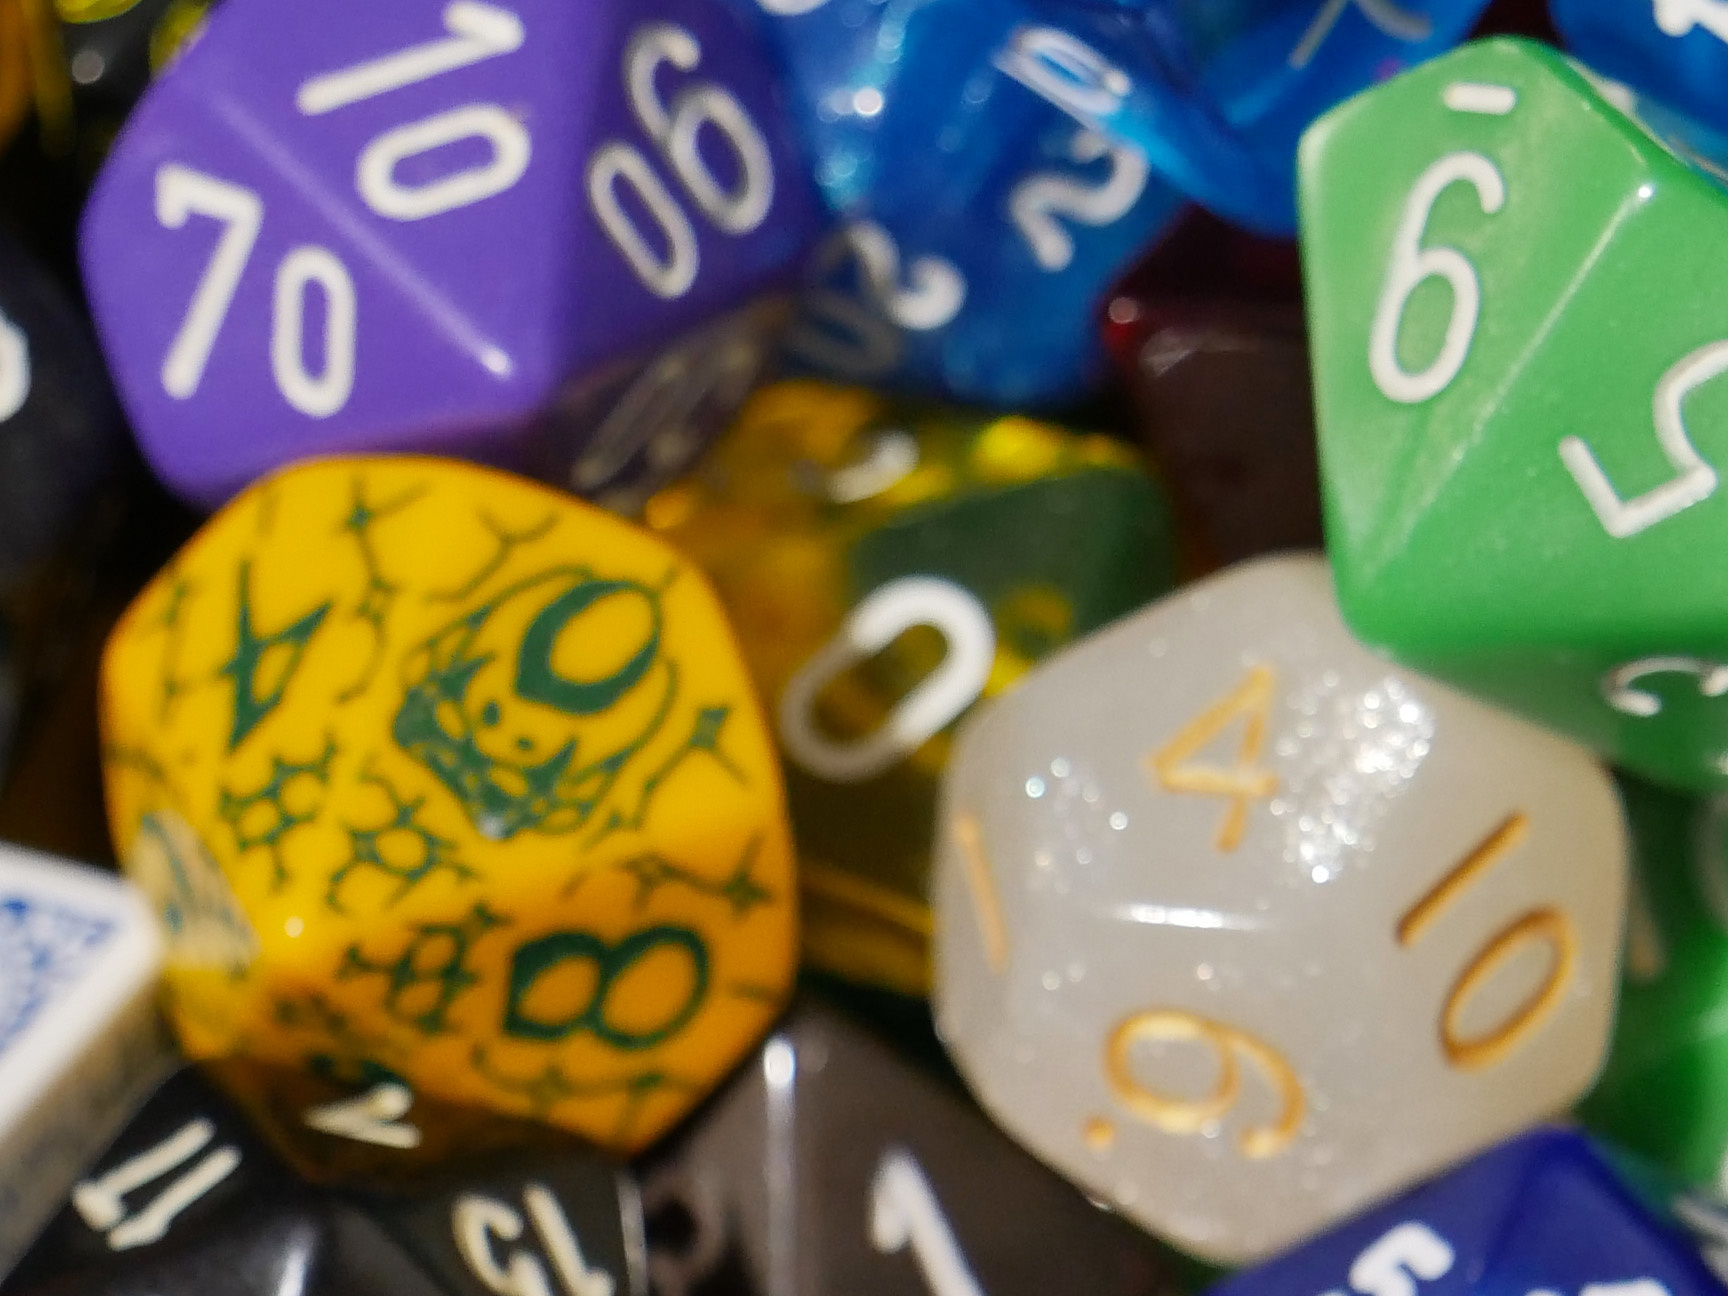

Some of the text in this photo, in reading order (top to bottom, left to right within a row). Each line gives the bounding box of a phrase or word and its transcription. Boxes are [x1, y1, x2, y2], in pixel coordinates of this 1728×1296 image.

[296, 0, 530, 221] 10
[154, 162, 357, 419] 70
[1146, 662, 1278, 854] 4
[502, 923, 712, 1050] 8
[1396, 812, 1578, 1072] 10
